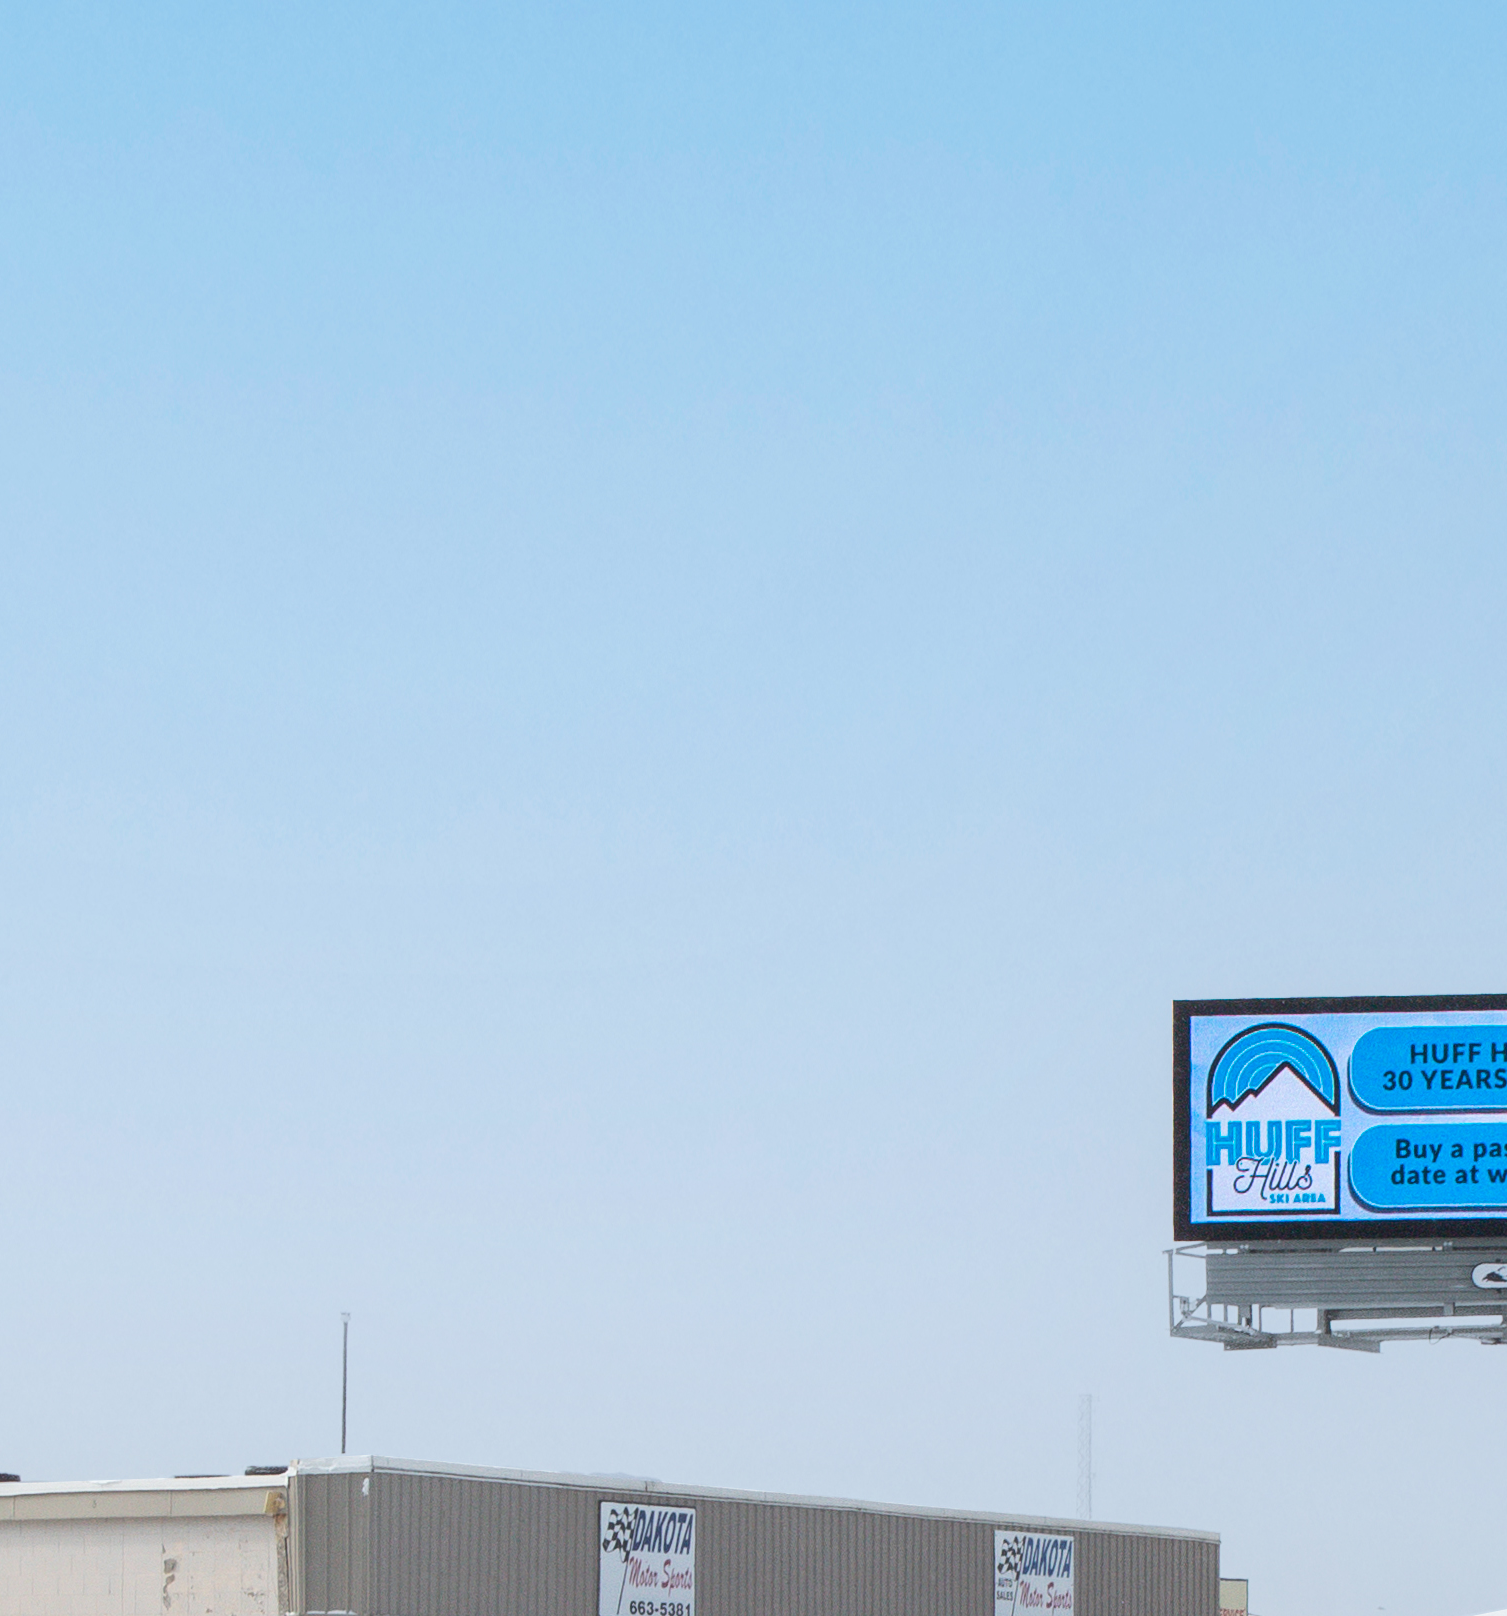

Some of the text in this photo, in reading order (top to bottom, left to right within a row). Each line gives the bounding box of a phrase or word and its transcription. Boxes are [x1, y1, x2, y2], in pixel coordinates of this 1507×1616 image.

[1410, 1043, 1482, 1064] HUFF
[1382, 1070, 1413, 1091] 30
[1421, 1068, 1507, 1090] YEARS
[1205, 1119, 1342, 1166] HUFF
[1395, 1138, 1442, 1163] Buy
[1451, 1142, 1464, 1158] a
[1233, 1156, 1313, 1200] Hills
[1391, 1163, 1446, 1185] date
[1454, 1165, 1479, 1184] at
[1269, 1193, 1326, 1204] SKI AREA
[631, 1508, 693, 1555] DAKOTA
[1022, 1537, 1072, 1578] DAKOTA
[628, 1555, 692, 1596] Motor Sports
[996, 1591, 1013, 1601] SALES
[1020, 1580, 1072, 1616] Motor Sports
